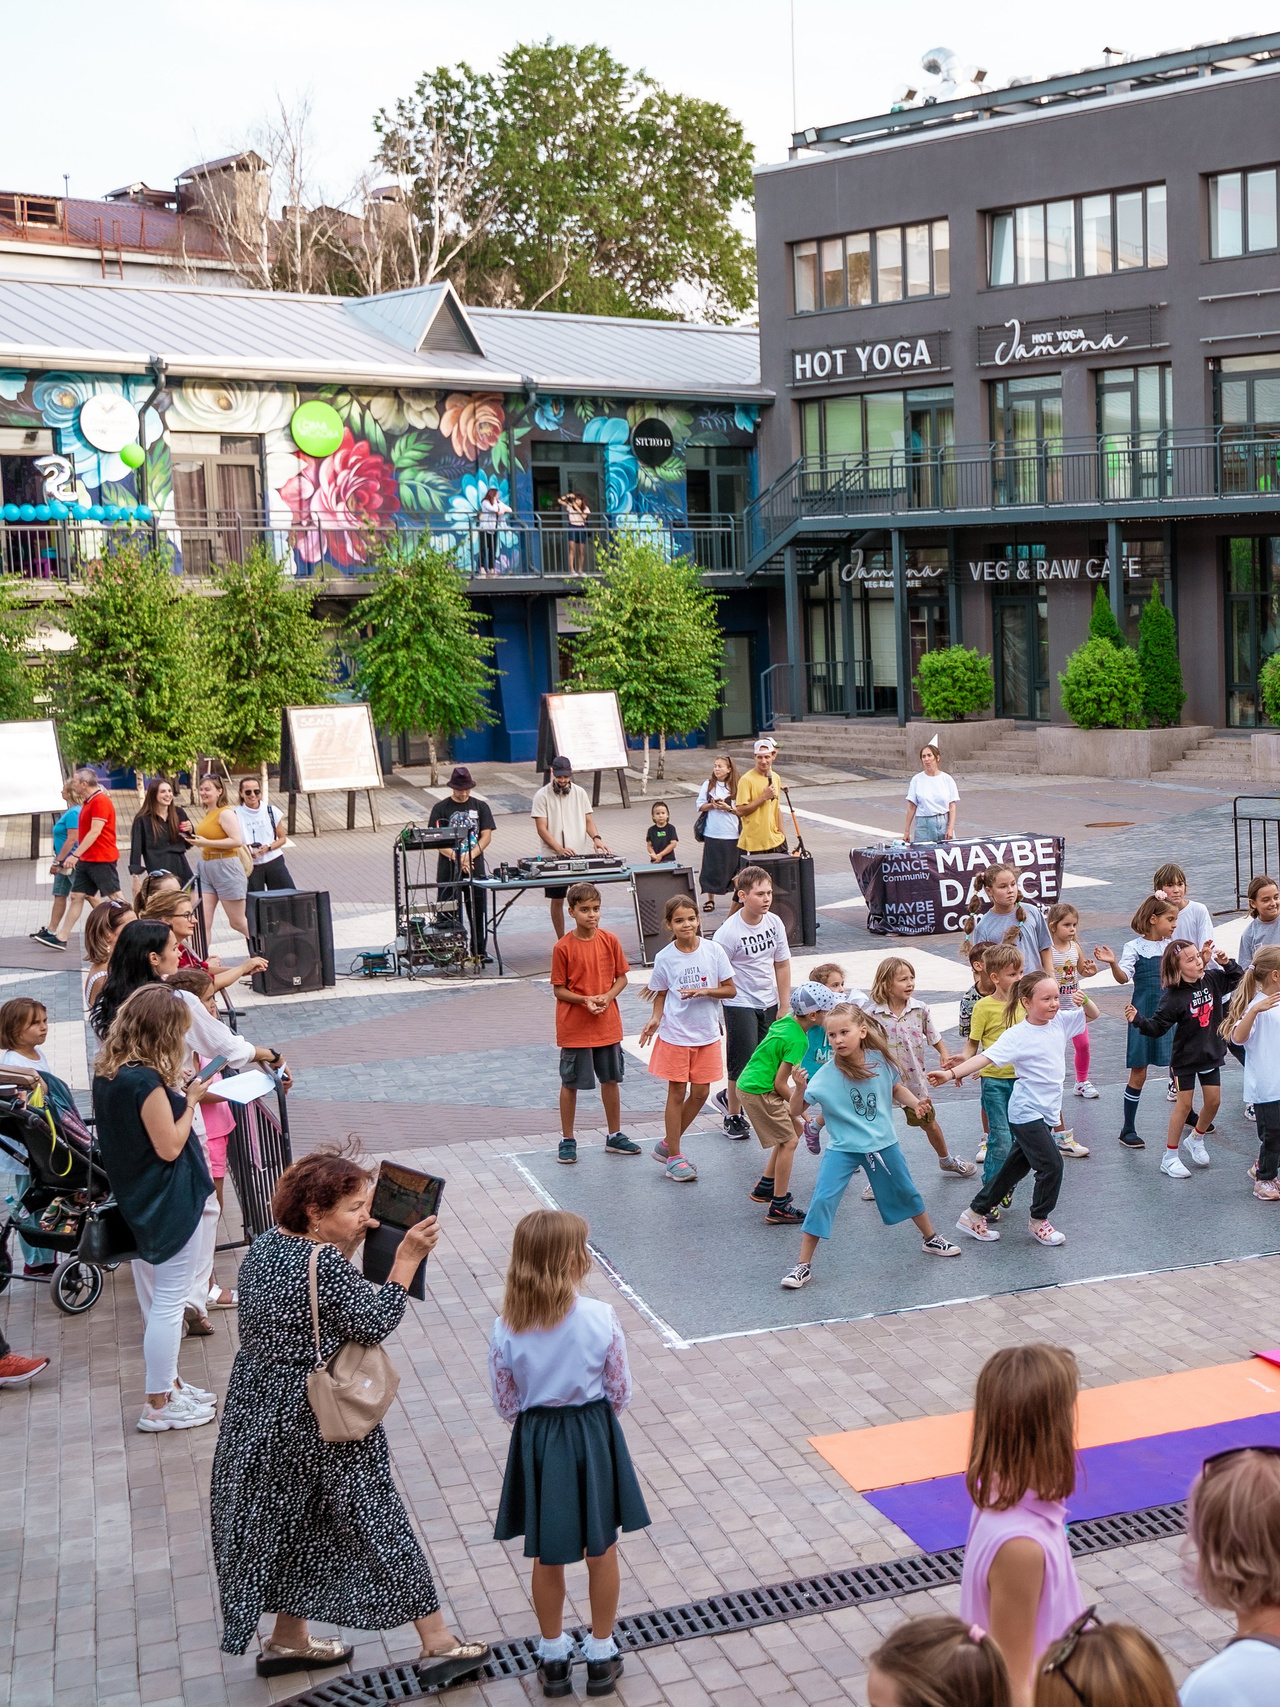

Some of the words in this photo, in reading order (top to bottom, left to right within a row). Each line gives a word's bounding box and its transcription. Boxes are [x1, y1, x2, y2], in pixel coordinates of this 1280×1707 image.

[995, 319, 1128, 365] Jamuna
[1031, 331, 1053, 344] HOT
[1056, 328, 1085, 341] YOGA
[794, 349, 847, 380] HOT
[855, 339, 932, 372] YOGA
[969, 561, 1010, 581] VEG
[1016, 561, 1030, 580] &
[1036, 559, 1081, 580] RAW
[934, 838, 1056, 874] MAYBE
[882, 860, 929, 874] DANCE
[882, 872, 930, 883] Community
[939, 870, 1057, 908] DACE
[885, 900, 934, 914] MAYBE
[886, 913, 936, 925] DANCE
[679, 974, 700, 984] CHILD
[684, 967, 696, 976] JUST
